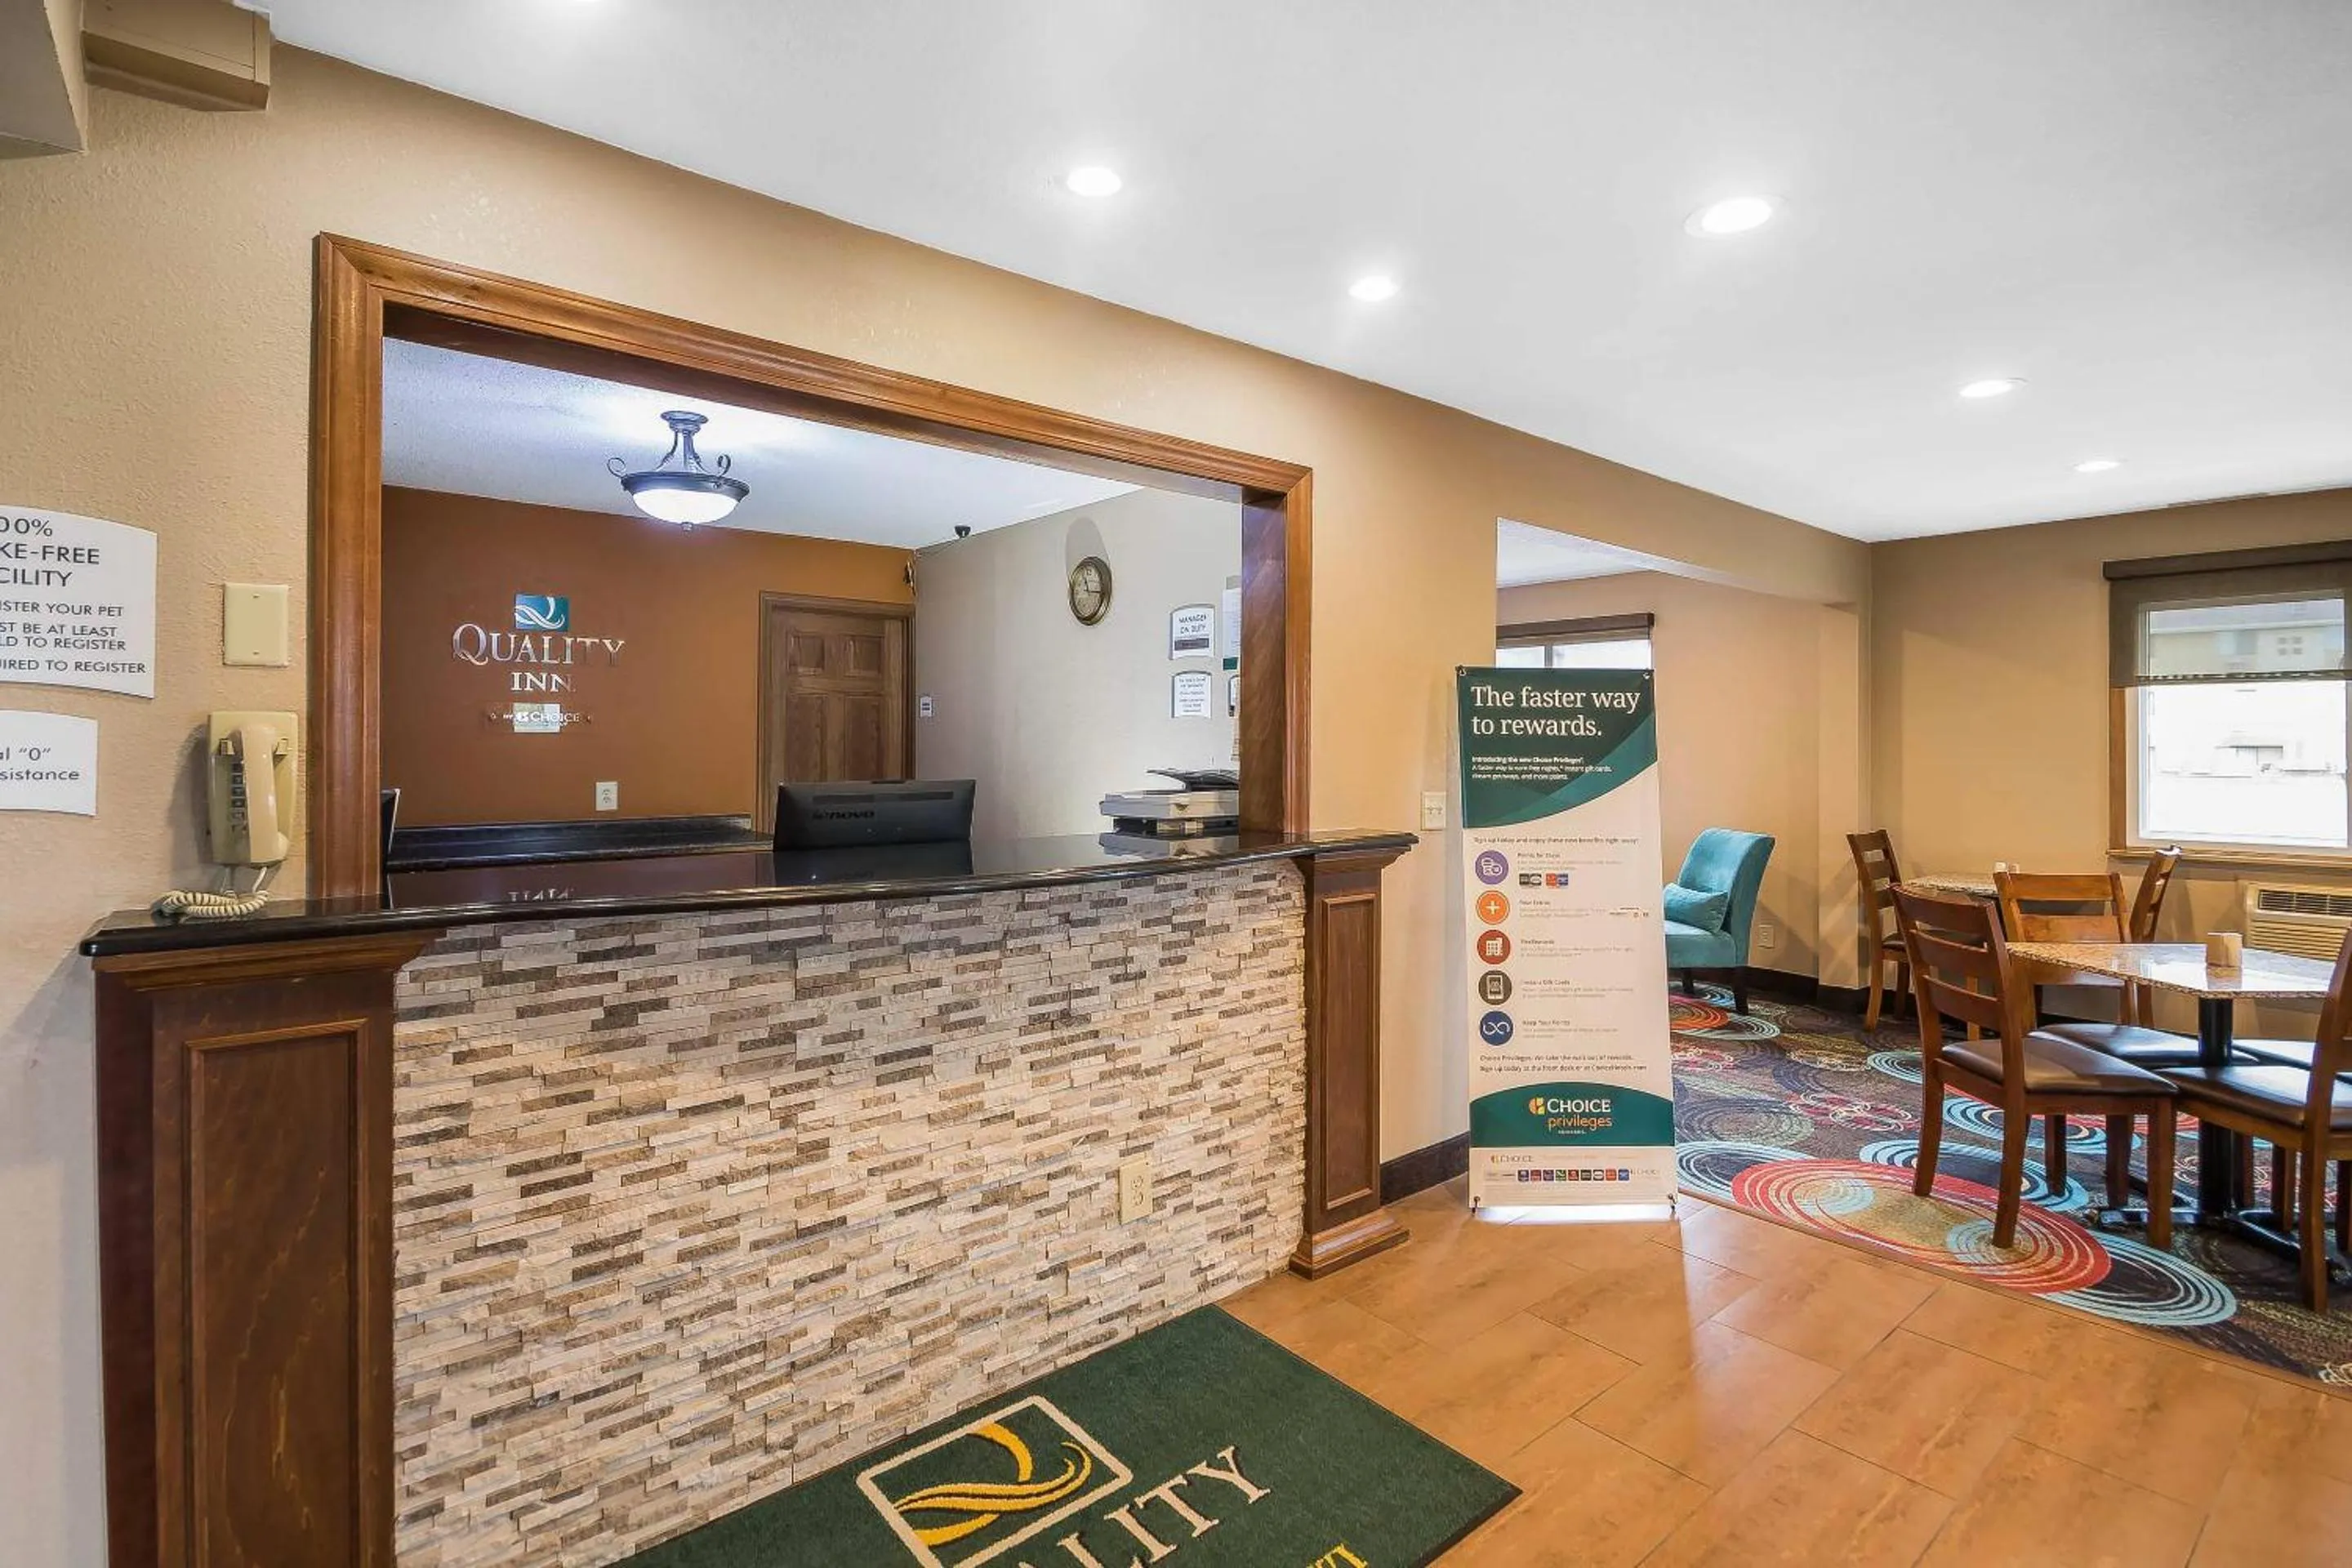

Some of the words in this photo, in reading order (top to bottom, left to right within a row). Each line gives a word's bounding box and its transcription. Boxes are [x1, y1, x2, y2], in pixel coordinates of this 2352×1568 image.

[0, 542, 100, 564] KE-FREE
[0, 567, 73, 586] CILITY
[46, 603, 92, 616] YOUR
[98, 606, 124, 617] PET
[23, 622, 42, 634] BE
[47, 624, 66, 635] AT
[72, 625, 118, 637] LEAST
[24, 636, 47, 648] TO
[54, 638, 127, 651] REGISTER
[452, 623, 626, 666] QUALITY
[45, 660, 69, 671] TO
[74, 661, 146, 674] REGISTER
[510, 672, 571, 693] INN
[1471, 685, 1515, 707] The
[1521, 685, 1587, 708] faster
[1591, 692, 1641, 715] way
[1472, 715, 1494, 736] to
[1499, 715, 1602, 737] rewards.
[0, 768, 80, 781] sistance
[1547, 1098, 1611, 1113] CHOICE
[1548, 1114, 1613, 1132] privileges
